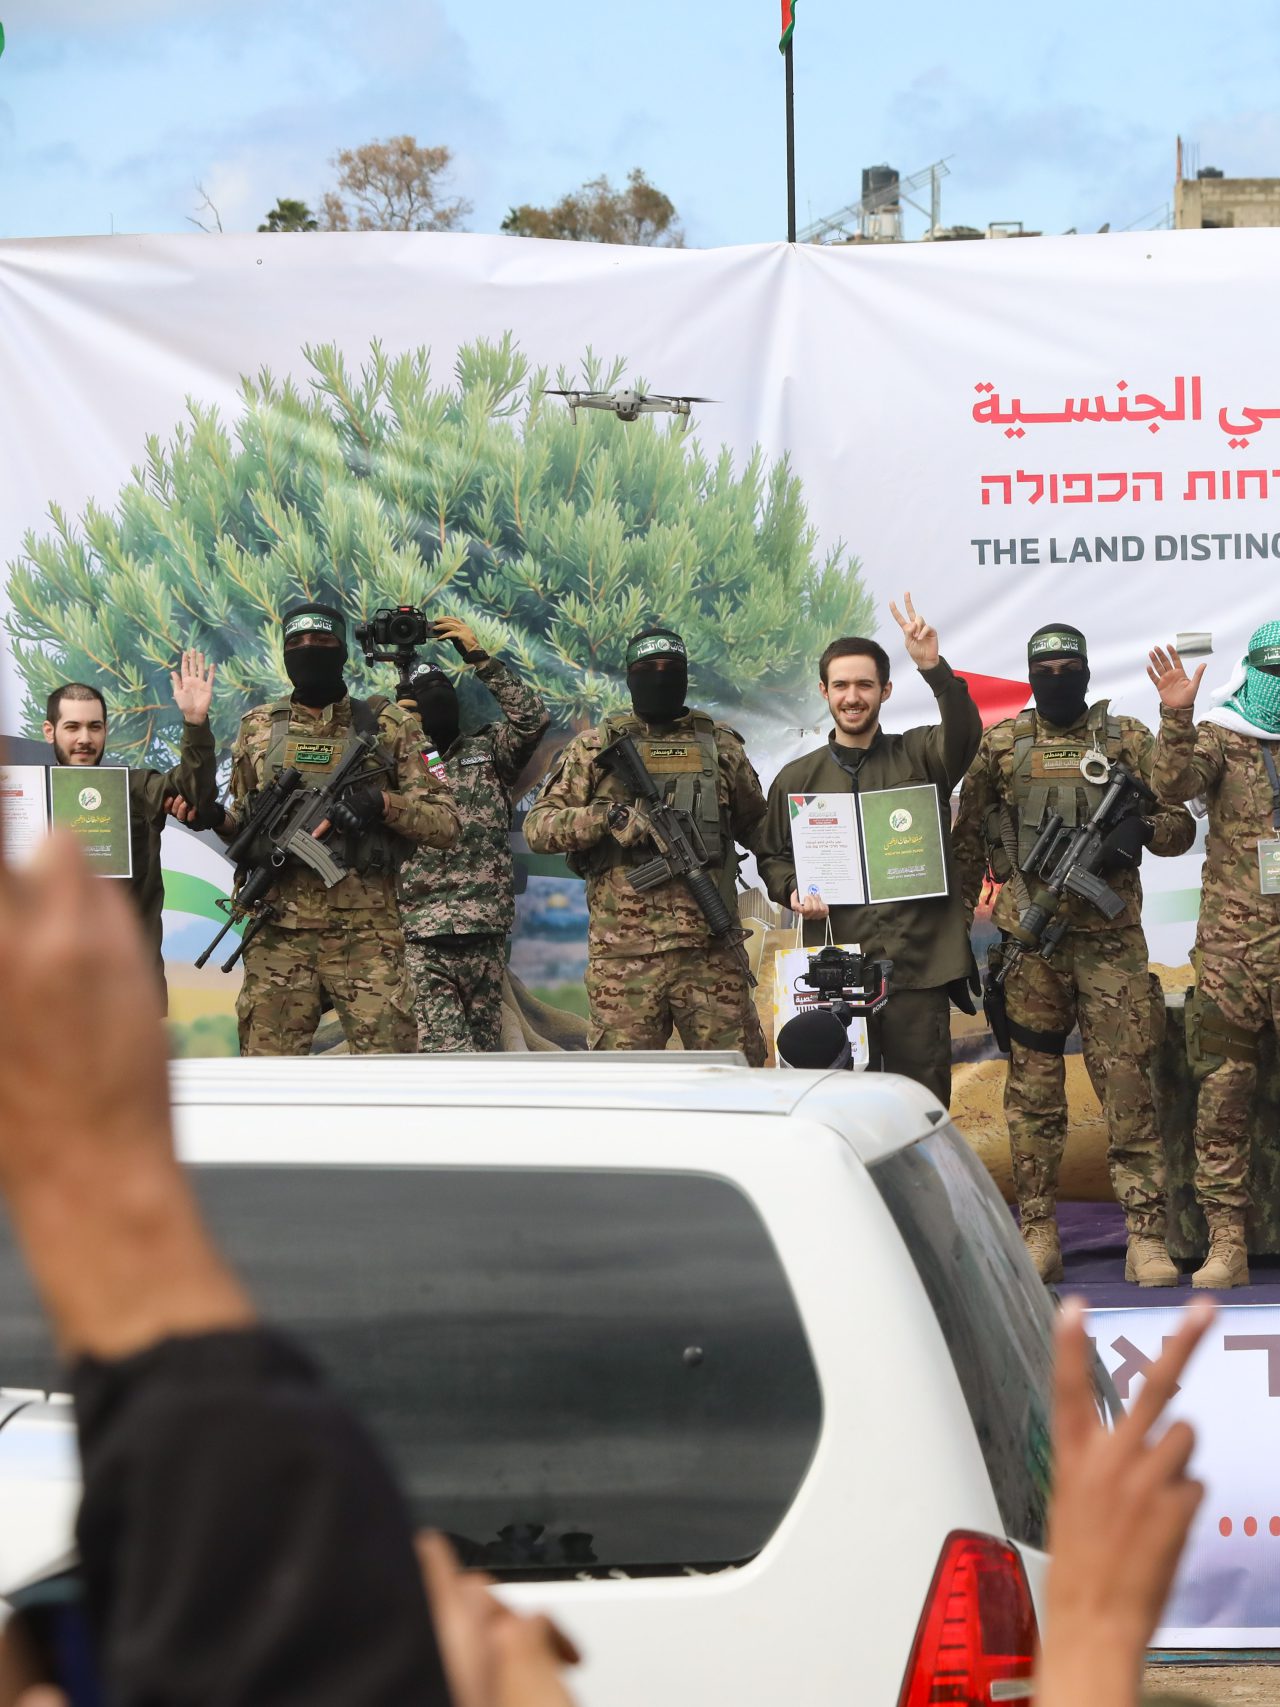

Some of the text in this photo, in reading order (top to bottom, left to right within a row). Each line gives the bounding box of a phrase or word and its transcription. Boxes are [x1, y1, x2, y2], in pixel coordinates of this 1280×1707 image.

[973, 377, 1202, 439] الجنسية
[982, 470, 1164, 506] הכפולה
[972, 539, 1041, 566] THE
[1051, 537, 1146, 565] LAND
